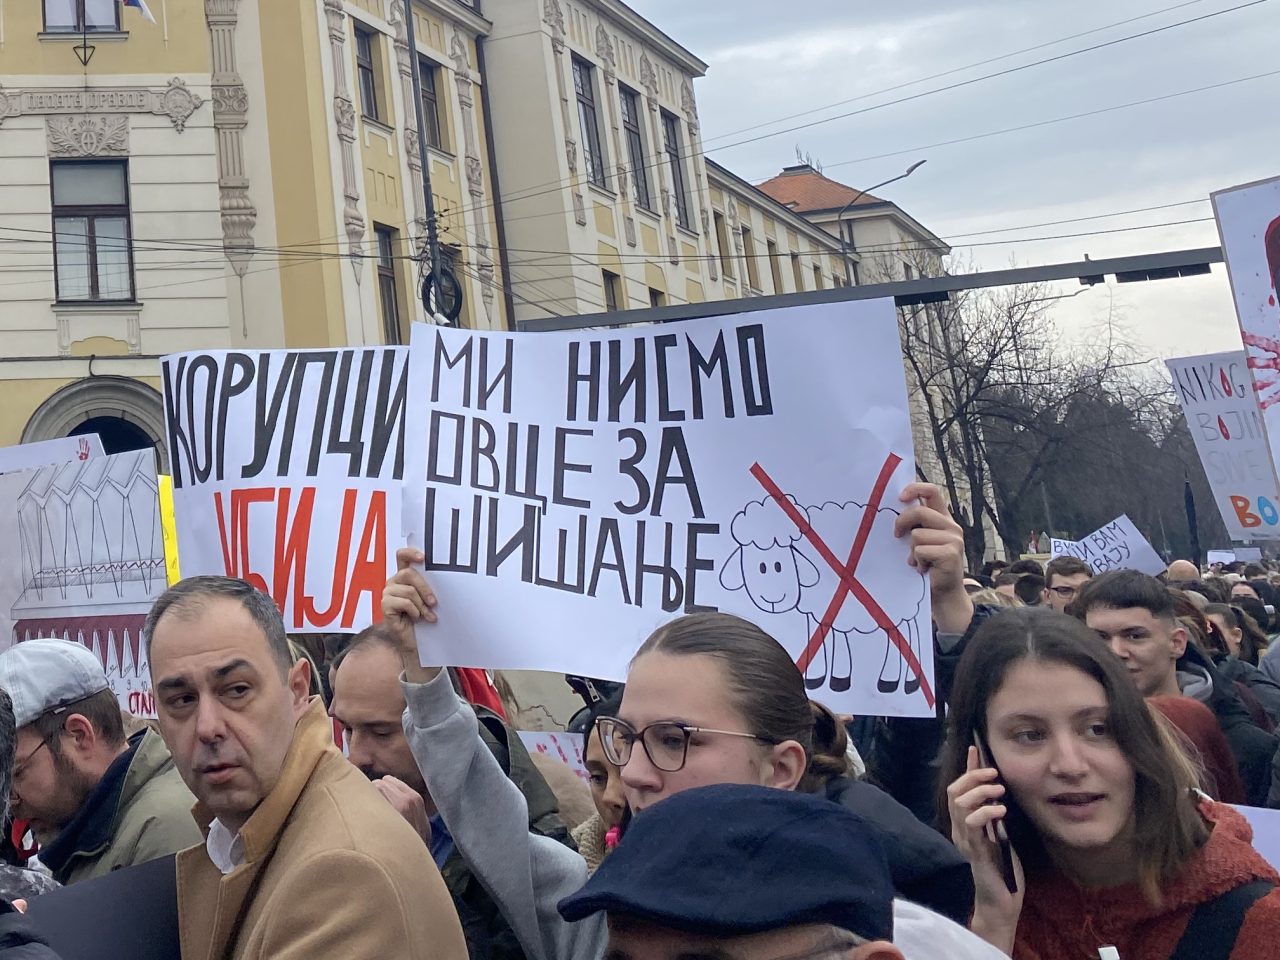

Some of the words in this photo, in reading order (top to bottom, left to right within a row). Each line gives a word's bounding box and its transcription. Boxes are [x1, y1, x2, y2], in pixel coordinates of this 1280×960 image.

[431, 329, 513, 413] МИ
[567, 324, 773, 423] НИСМО
[427, 410, 593, 515] ОВЦЕ
[614, 427, 705, 519] ЗА
[214, 487, 387, 628] УБИЈА
[425, 487, 720, 614] ШИШАЊЕ
[1090, 521, 1128, 551] ВАМ
